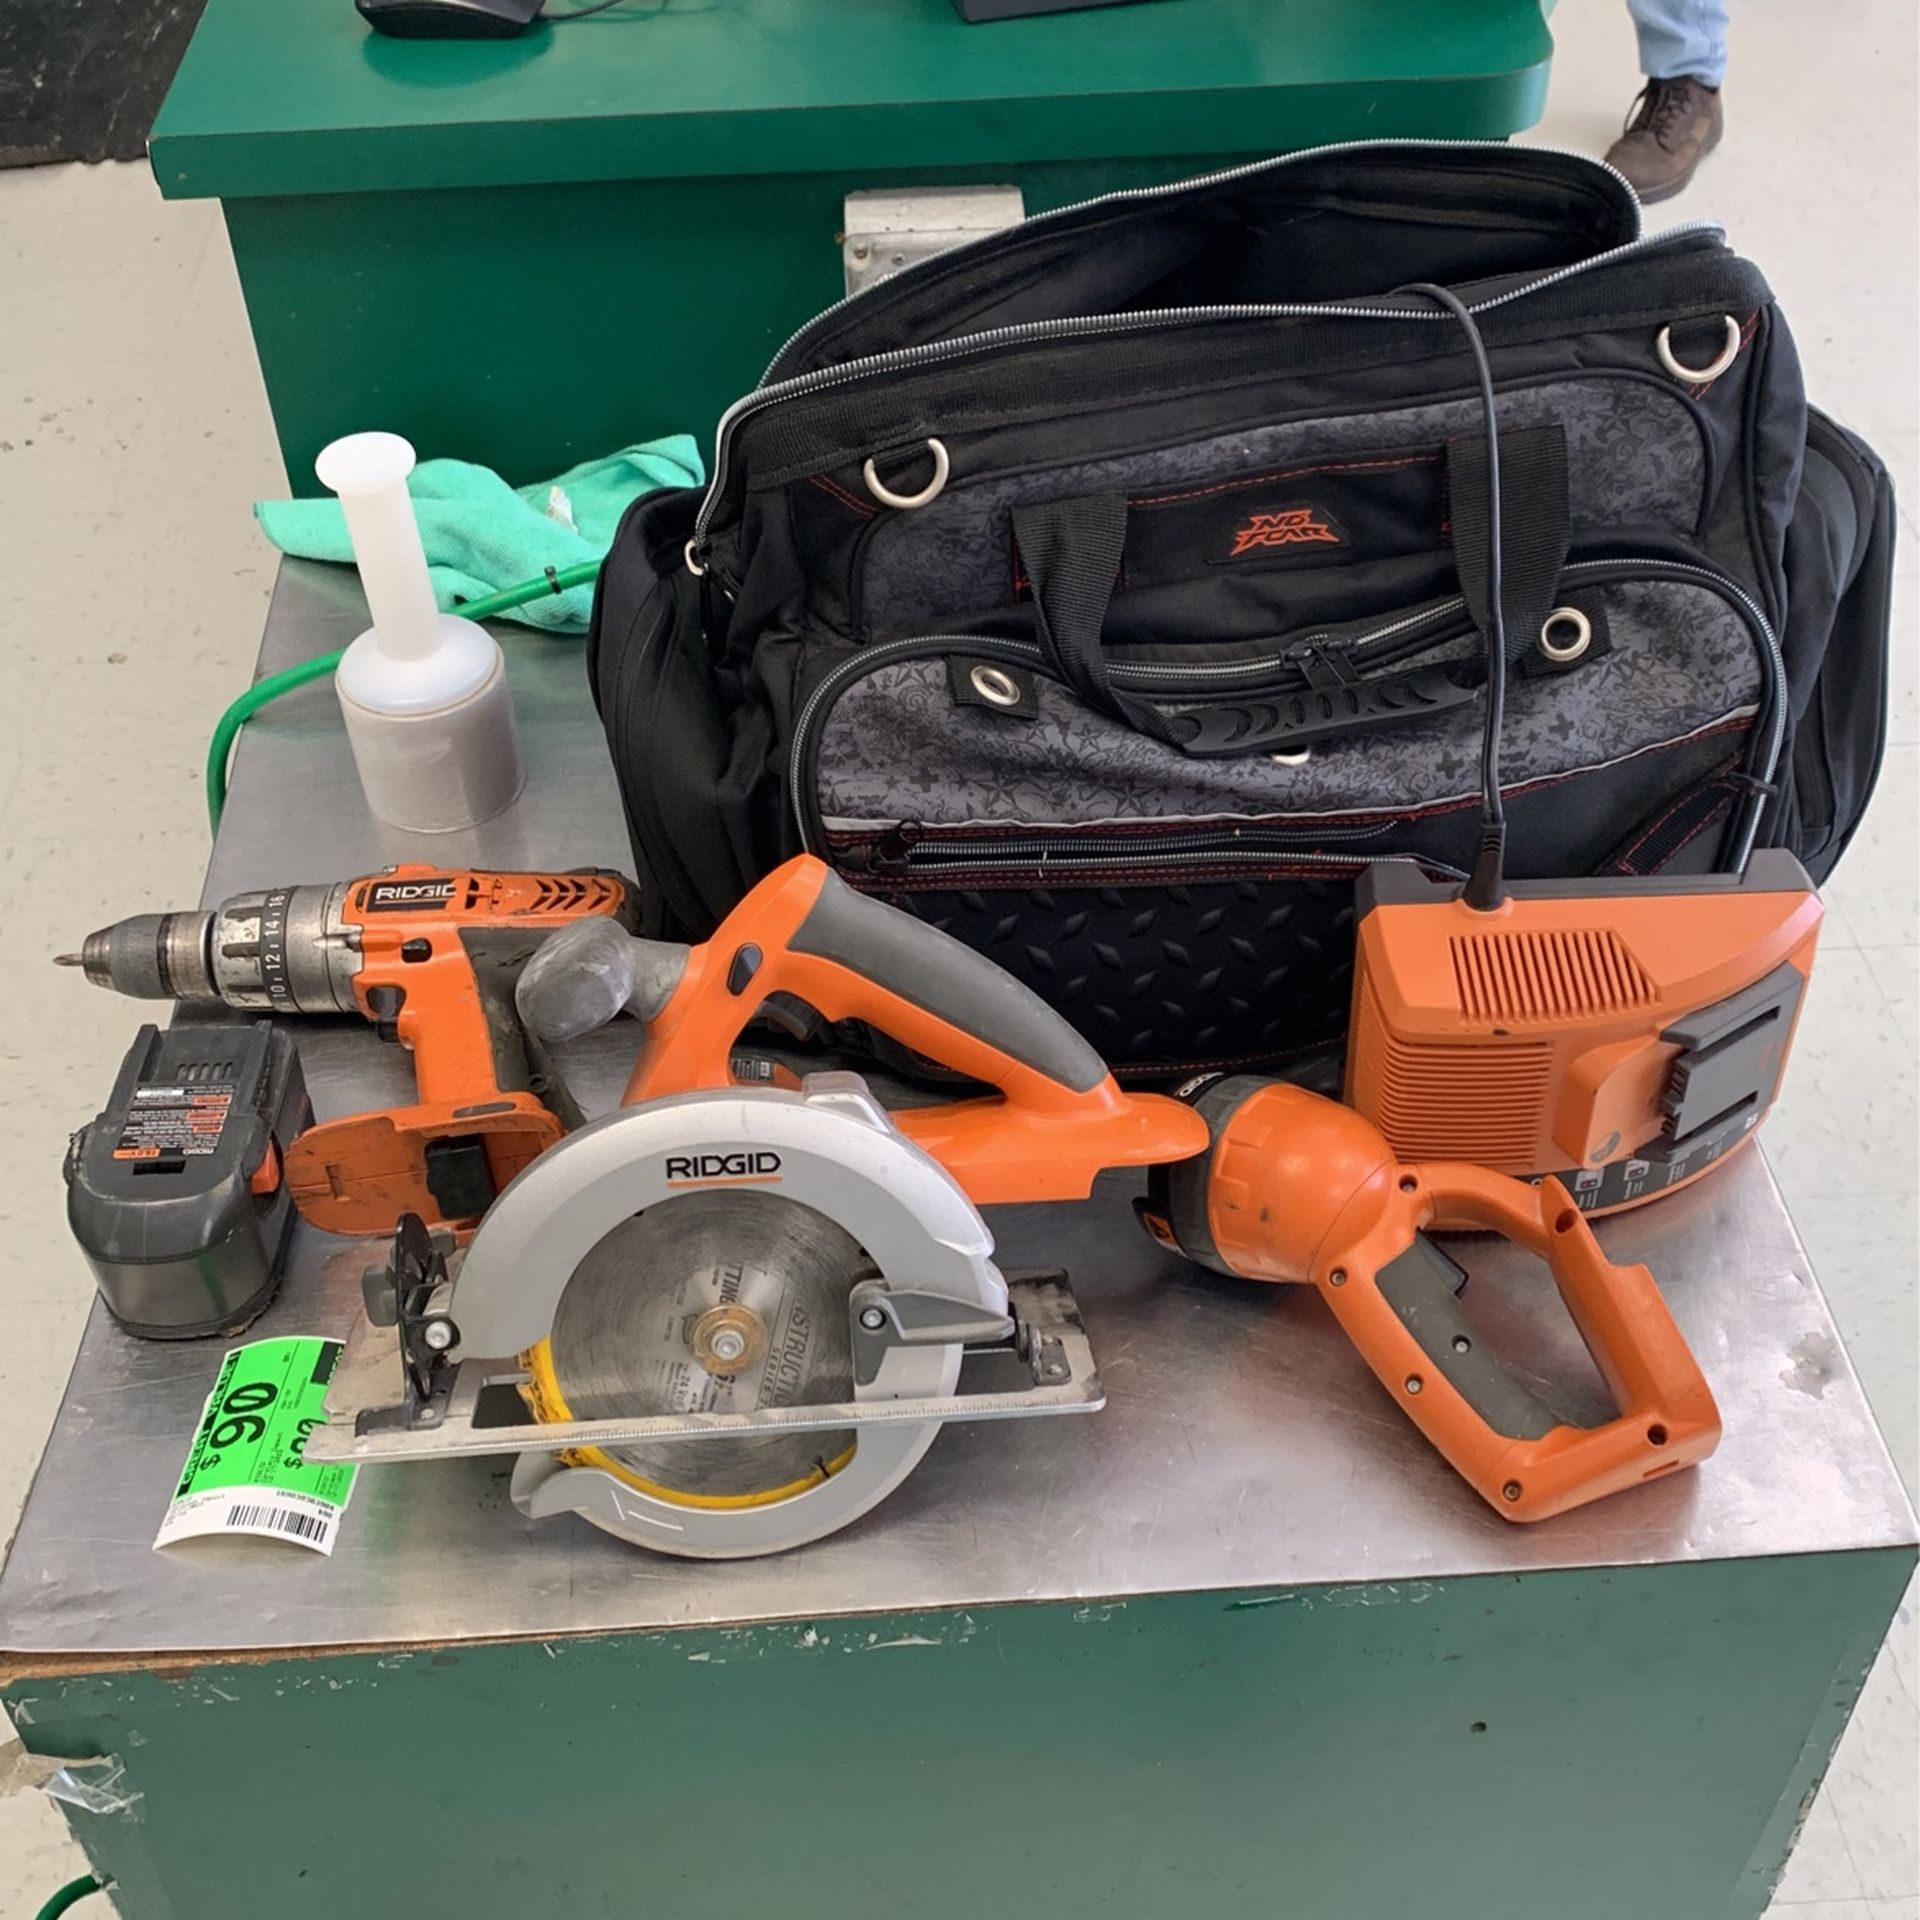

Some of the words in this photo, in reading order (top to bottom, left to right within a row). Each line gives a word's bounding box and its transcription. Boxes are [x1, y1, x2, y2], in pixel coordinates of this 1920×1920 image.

[1250, 510, 1311, 530] NO
[1231, 525, 1339, 555] FEAR
[269, 894, 286, 908] 16
[374, 884, 457, 900] RIDGID
[265, 919, 282, 937] 14
[265, 953, 282, 970] 12
[270, 984, 286, 998] 10
[665, 1152, 782, 1179] RIDGID
[182, 1429, 210, 1485] GREAT
